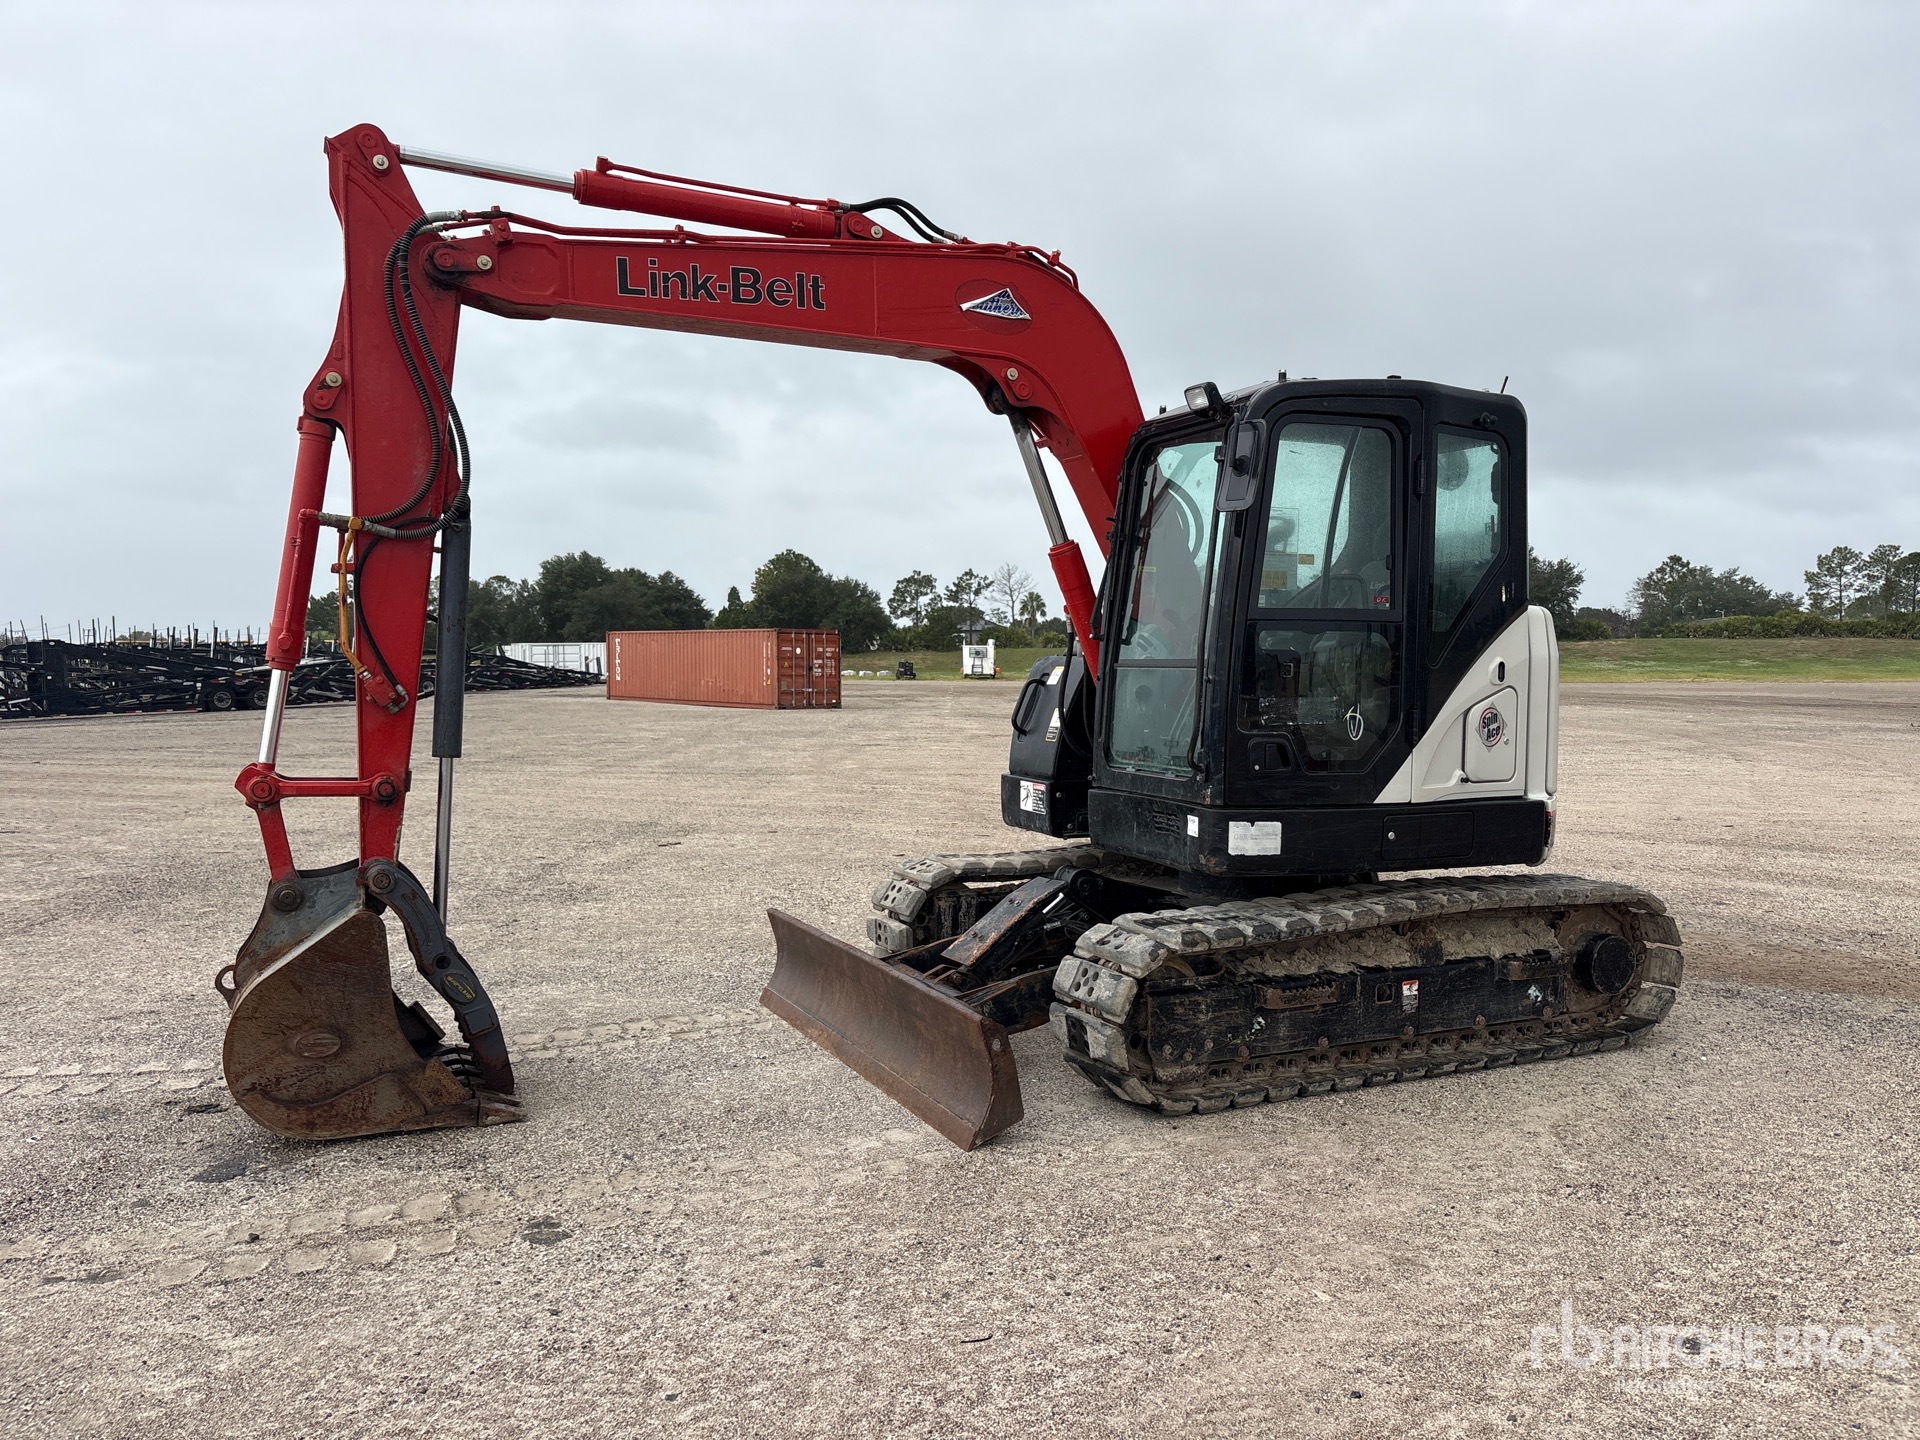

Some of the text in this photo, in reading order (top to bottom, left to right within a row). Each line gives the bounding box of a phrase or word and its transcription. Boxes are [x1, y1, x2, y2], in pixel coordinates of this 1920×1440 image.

[616, 256, 826, 311] Link-Belt
[1482, 713, 1498, 729] Spin
[1486, 725, 1501, 741] Ace
